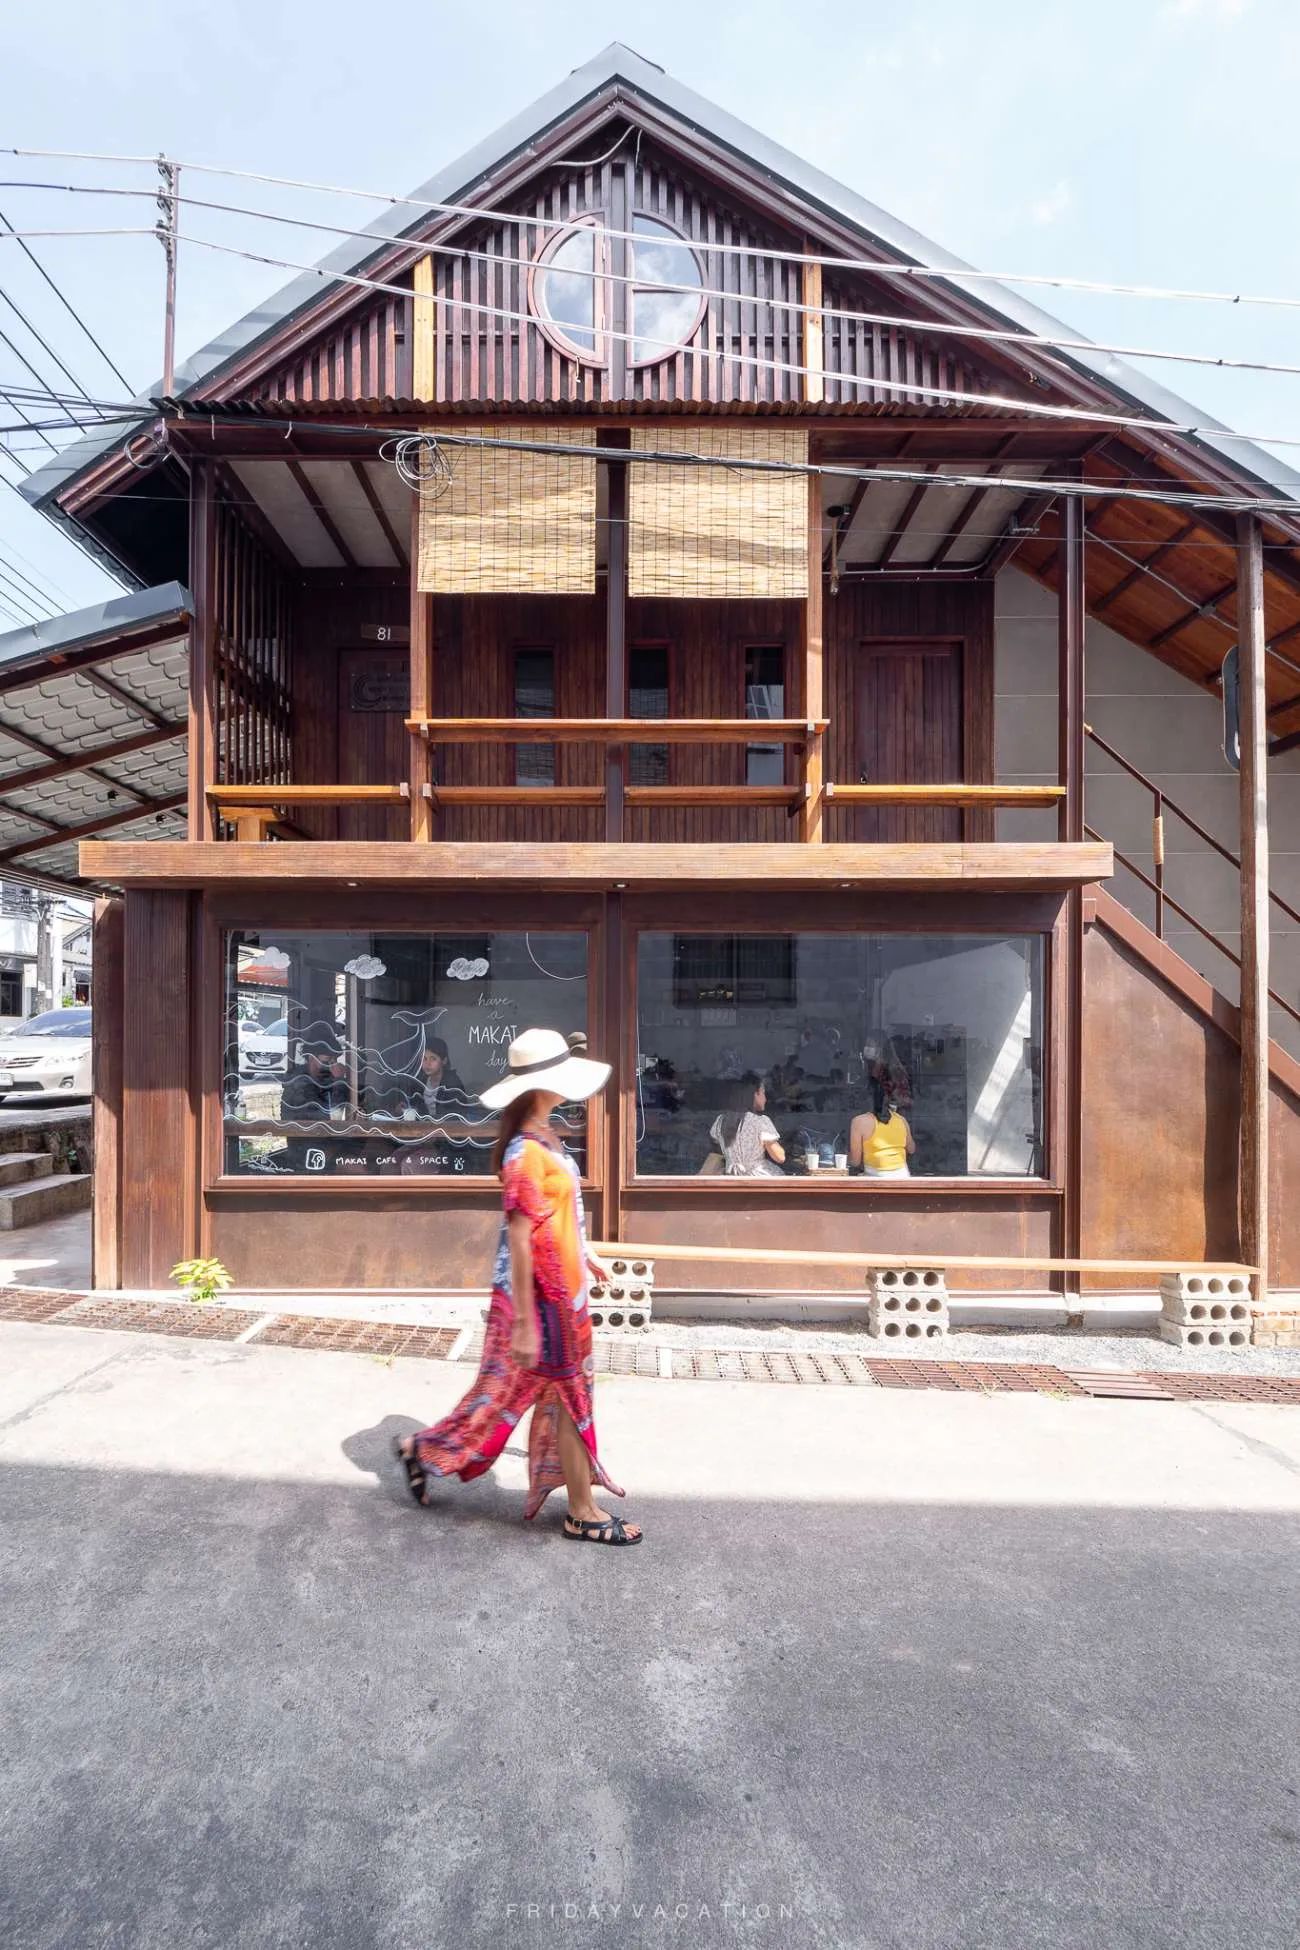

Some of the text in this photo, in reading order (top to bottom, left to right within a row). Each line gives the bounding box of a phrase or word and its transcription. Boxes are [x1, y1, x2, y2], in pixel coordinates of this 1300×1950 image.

[377, 627, 391, 641] 81
[478, 992, 513, 1006] have
[491, 1010, 504, 1019] a
[486, 1049, 508, 1074] day
[419, 1156, 449, 1165] SPACE
